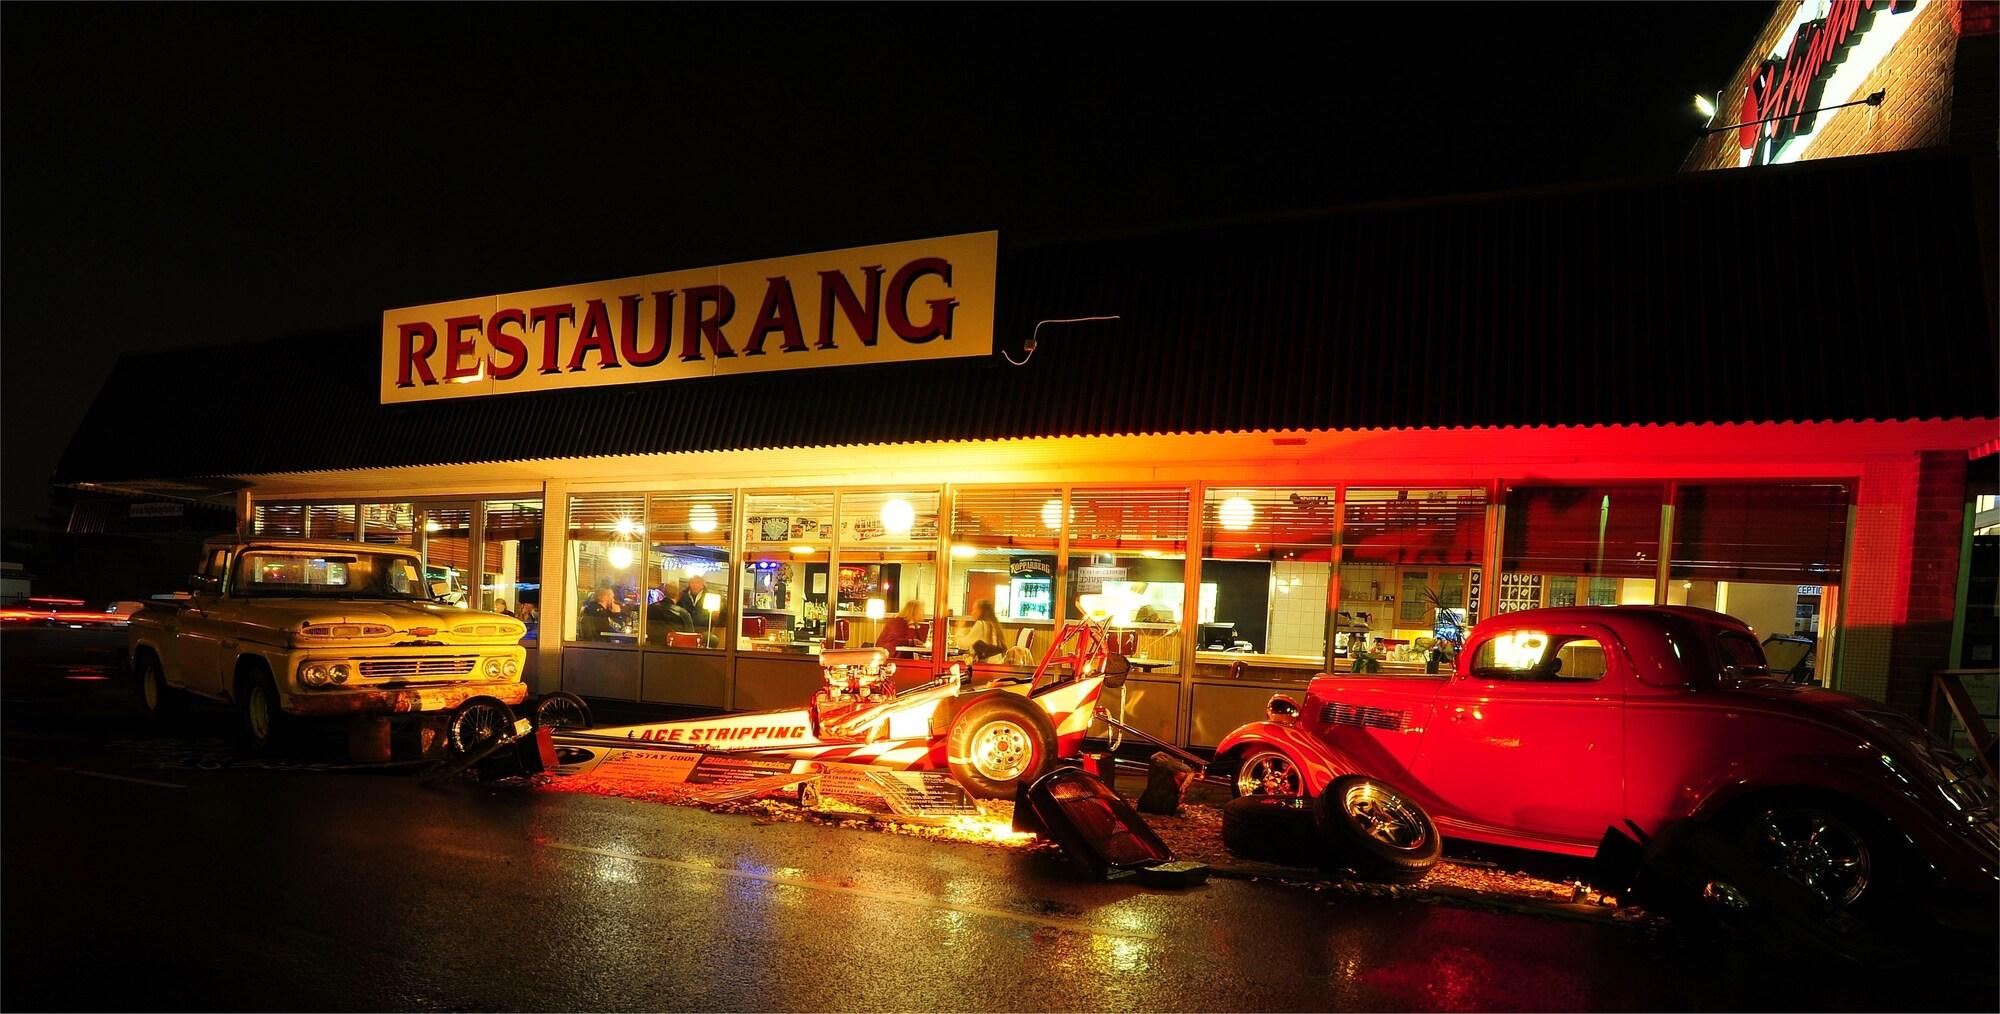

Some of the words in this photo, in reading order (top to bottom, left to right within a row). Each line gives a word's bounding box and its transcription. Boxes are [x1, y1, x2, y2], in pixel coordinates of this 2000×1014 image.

[395, 257, 960, 388] RESTAURANG
[641, 729, 684, 741] ACE
[689, 726, 805, 741] STRIPPING
[635, 752, 668, 760] STAY
